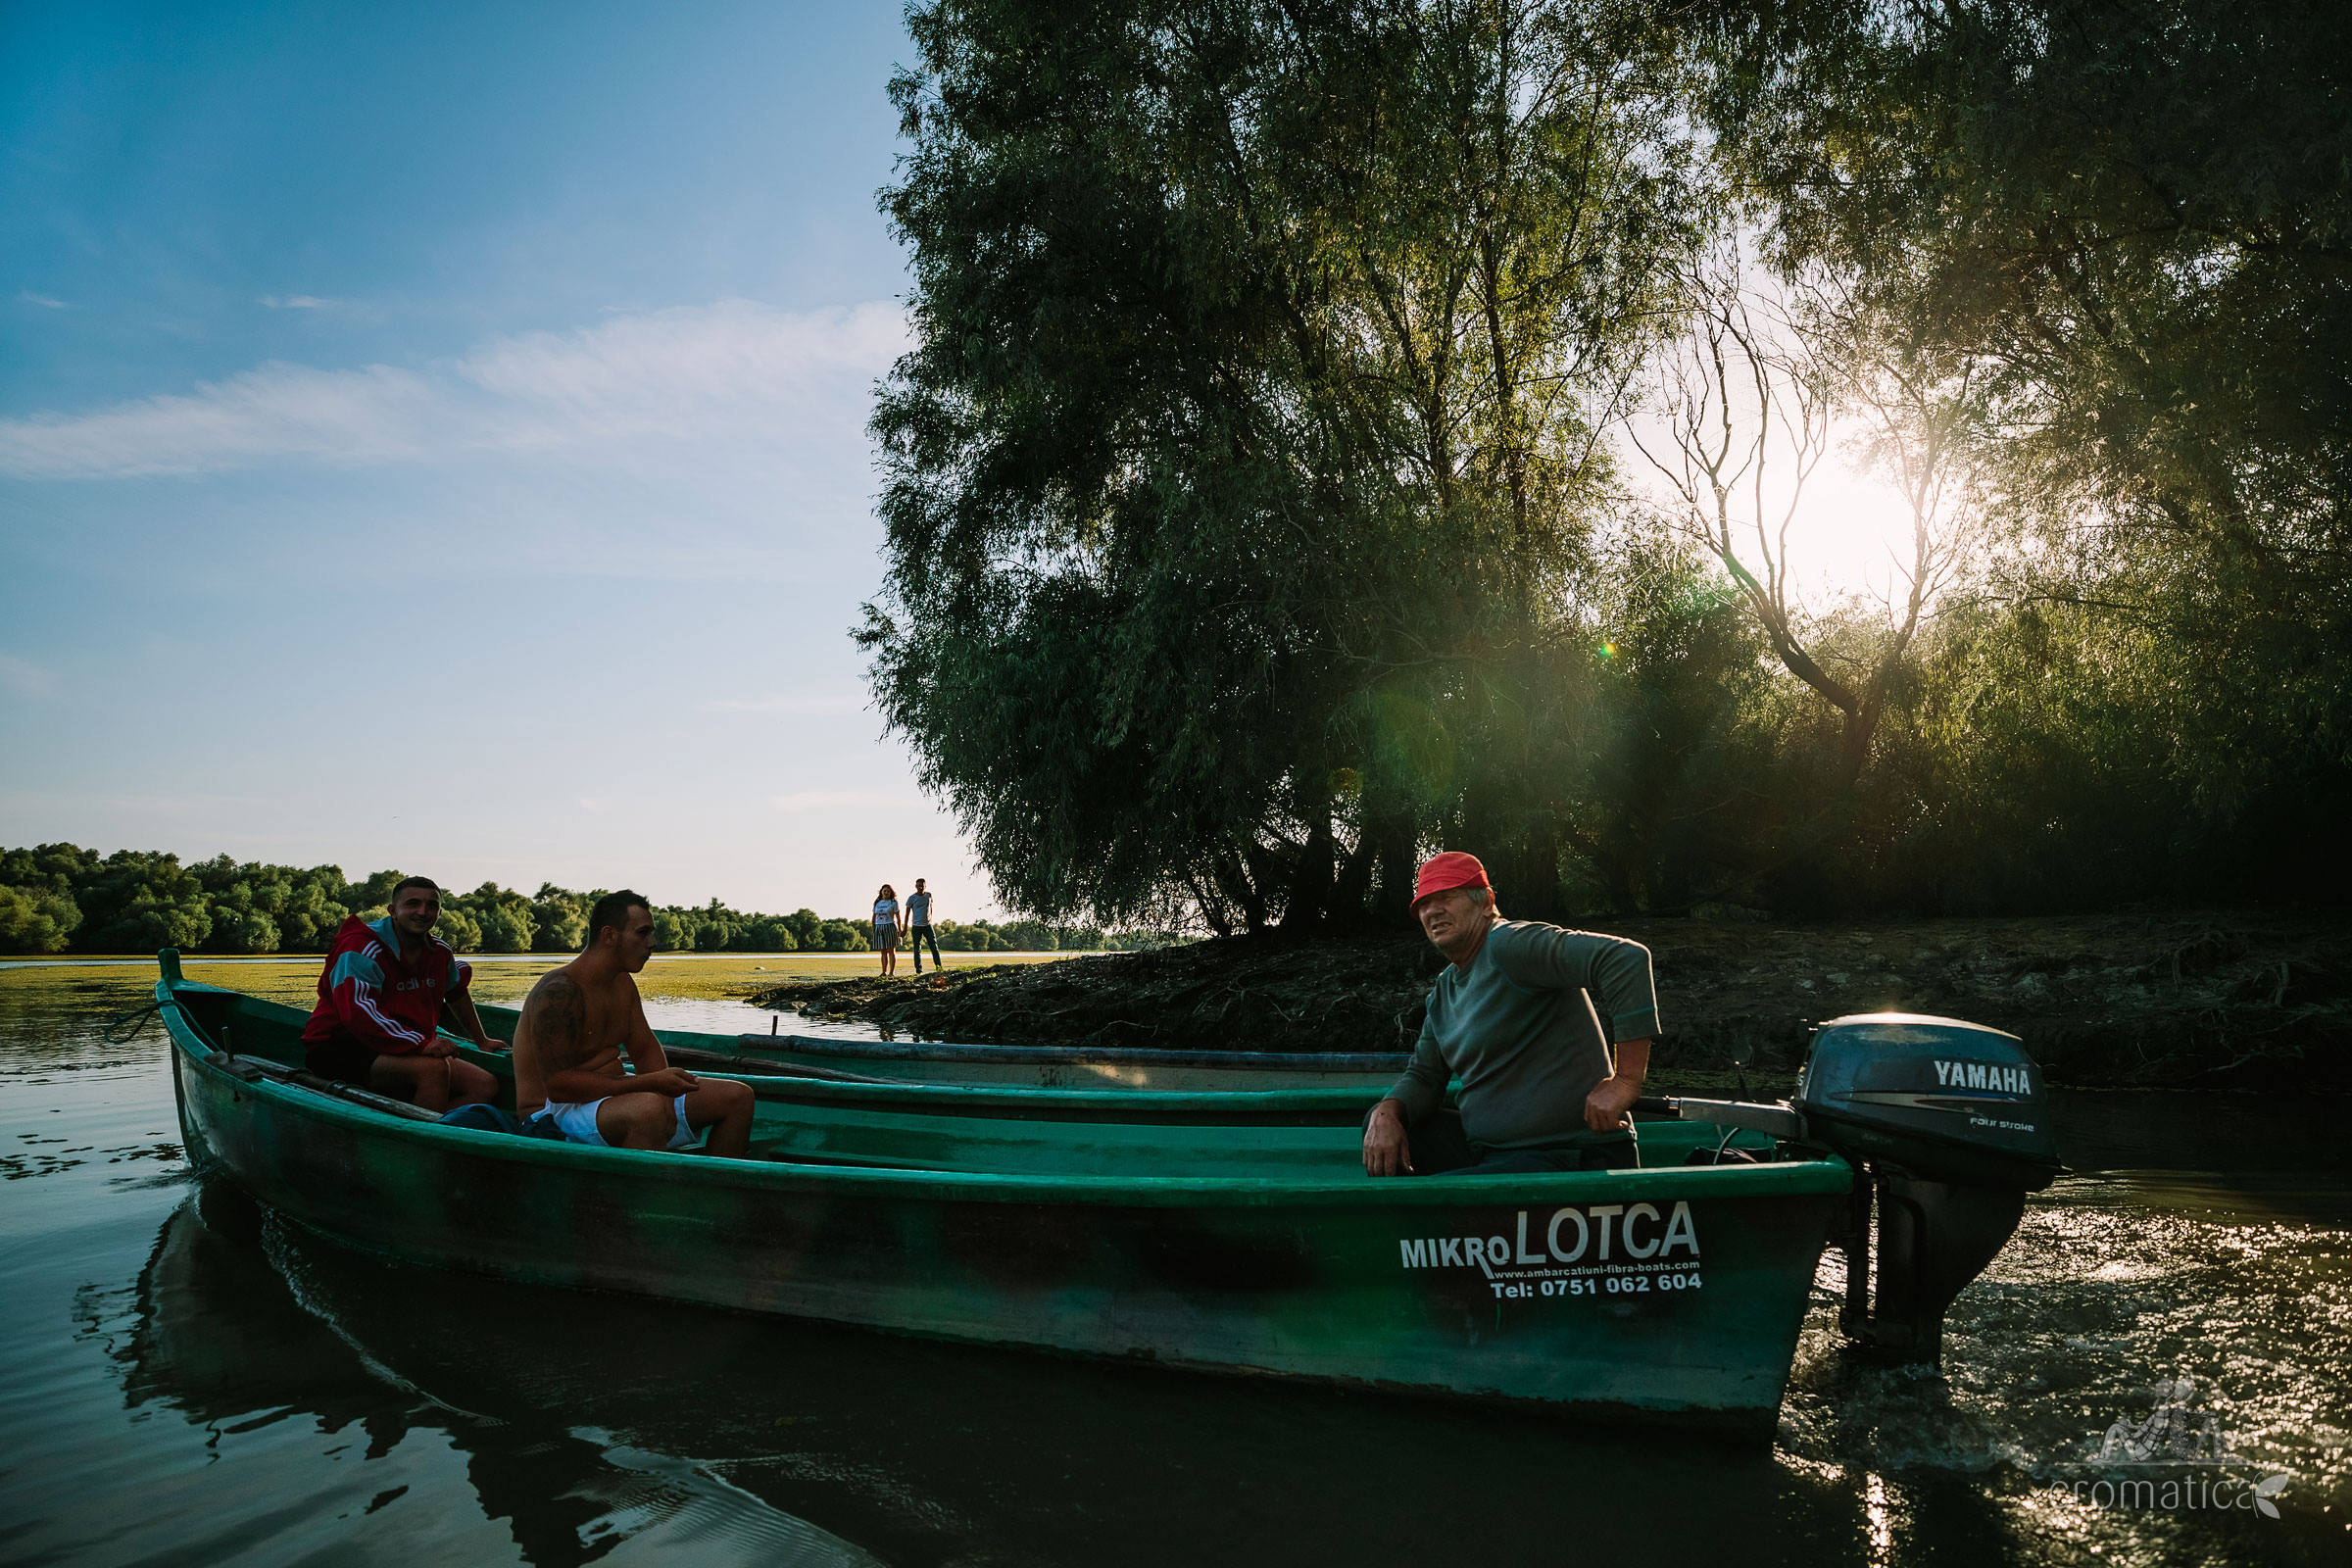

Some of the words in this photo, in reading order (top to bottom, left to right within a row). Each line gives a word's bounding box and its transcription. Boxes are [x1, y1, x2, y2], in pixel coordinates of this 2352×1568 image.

[1934, 1060, 2032, 1095] YAMAHA
[1399, 1236, 1510, 1280] MIKRO
[1516, 1200, 1701, 1264] LOTCA
[1494, 1260, 1700, 1279] www.ambarcatiuni-fibra-boats.com
[1491, 1281, 1533, 1298] Tel:
[1541, 1278, 1596, 1296] 0751
[1606, 1276, 1650, 1294] 062
[1658, 1273, 1702, 1290] 604
